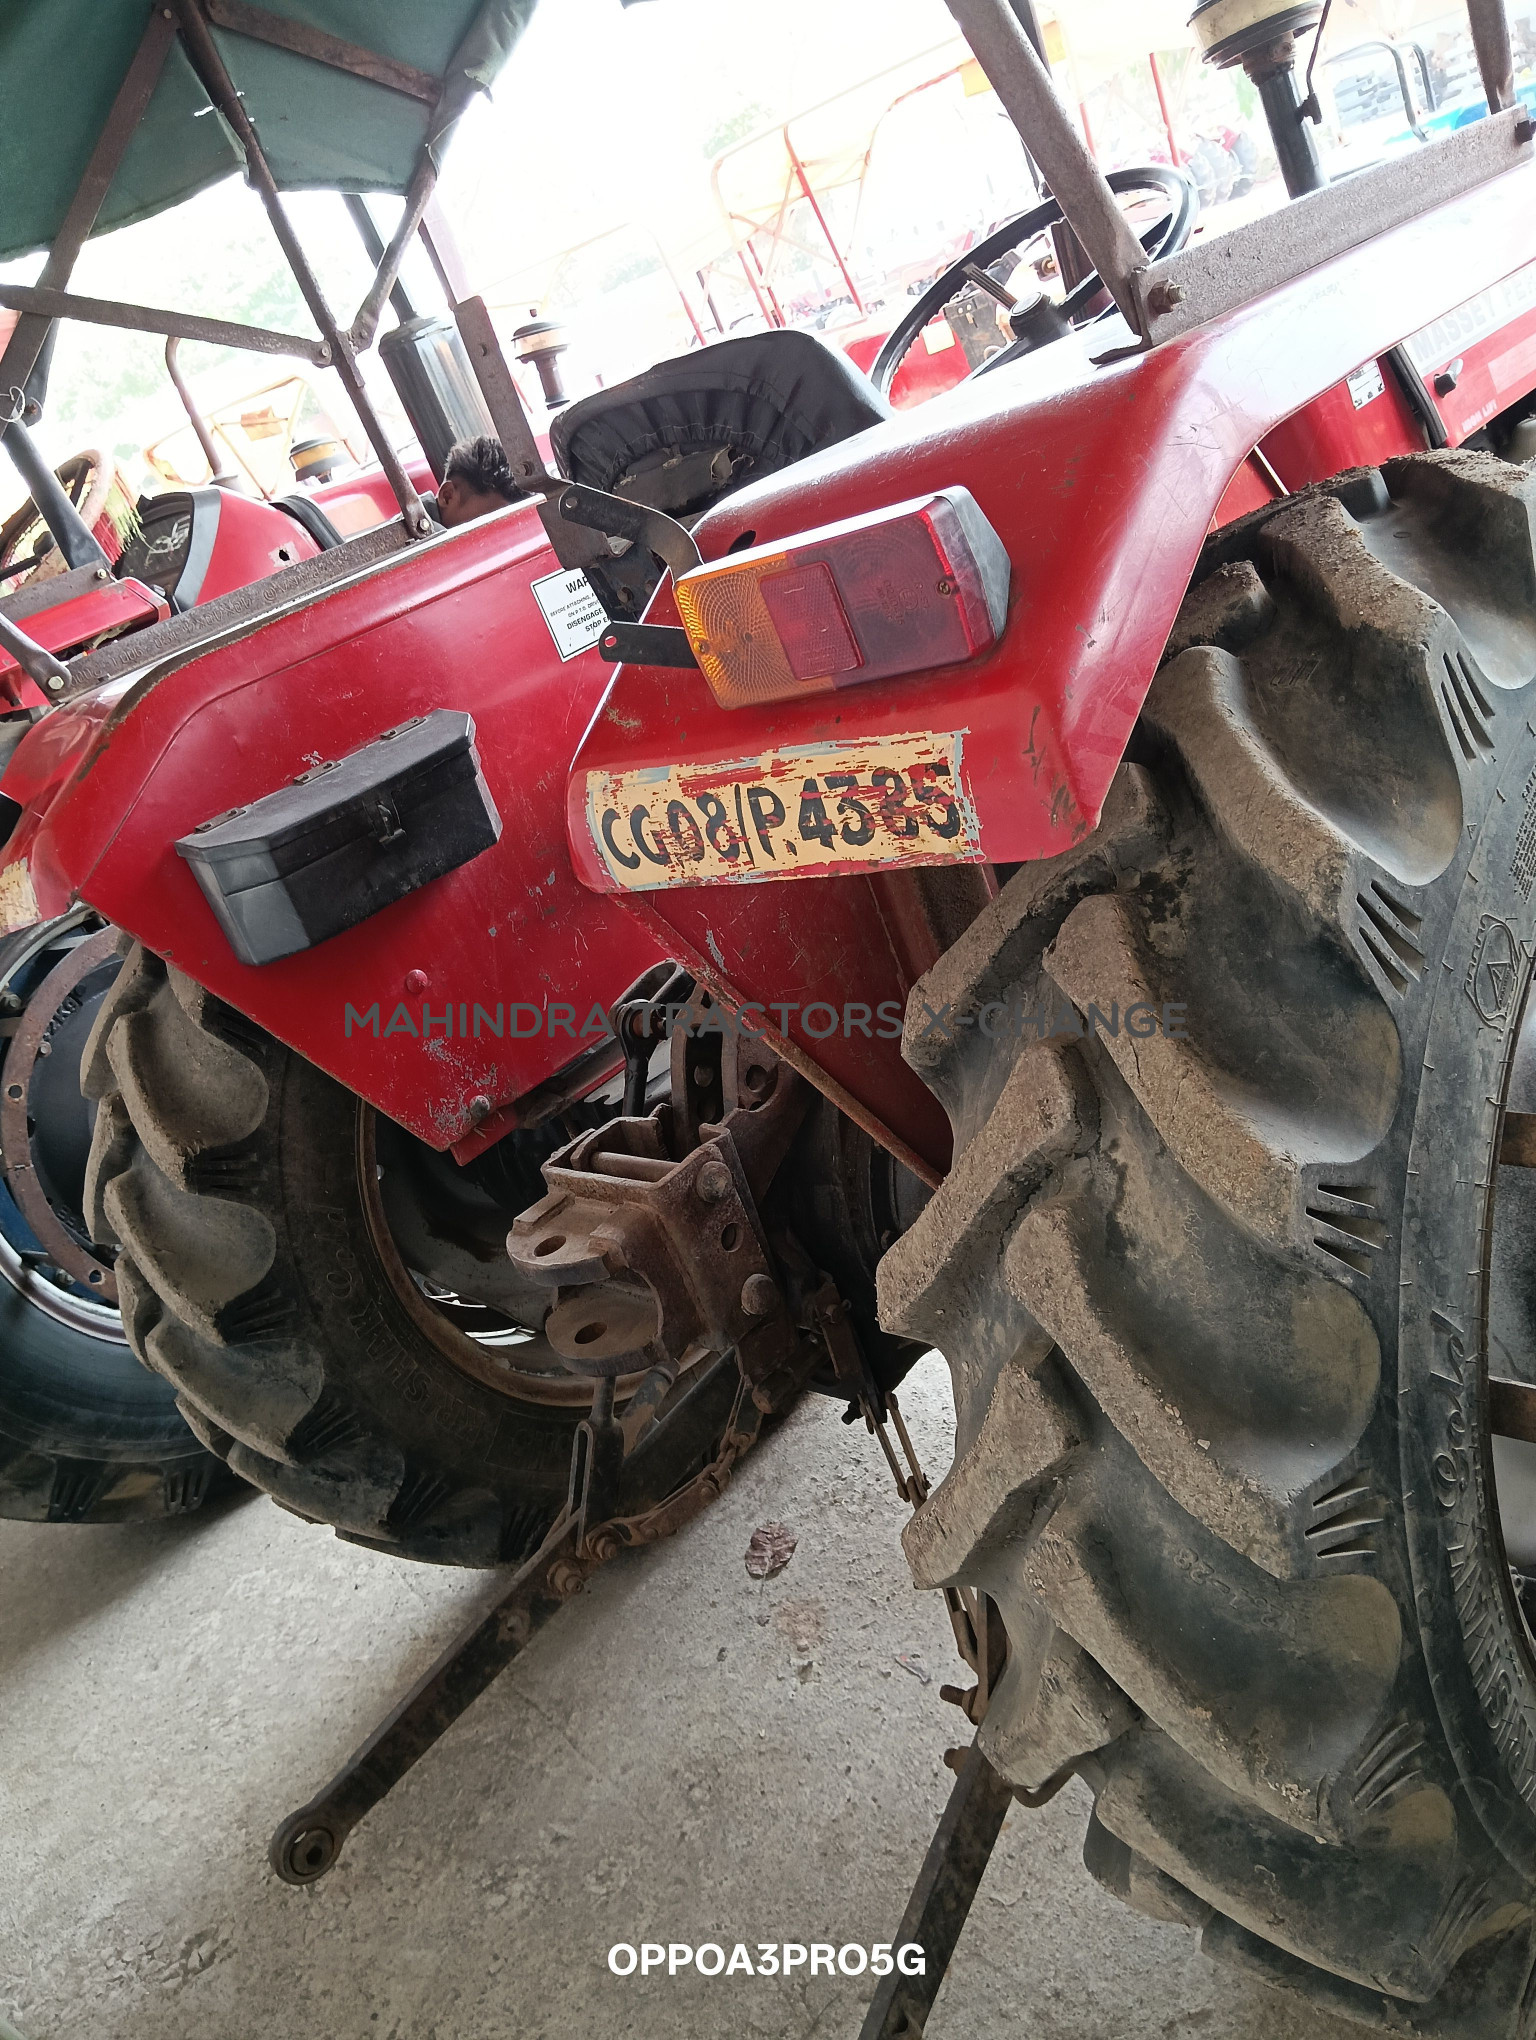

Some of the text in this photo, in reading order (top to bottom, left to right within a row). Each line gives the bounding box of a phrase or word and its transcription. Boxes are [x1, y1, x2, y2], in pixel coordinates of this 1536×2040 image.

[1410, 289, 1495, 362] MASSEY
[566, 607, 604, 630] DISENGAGE
[585, 619, 602, 632] STOP
